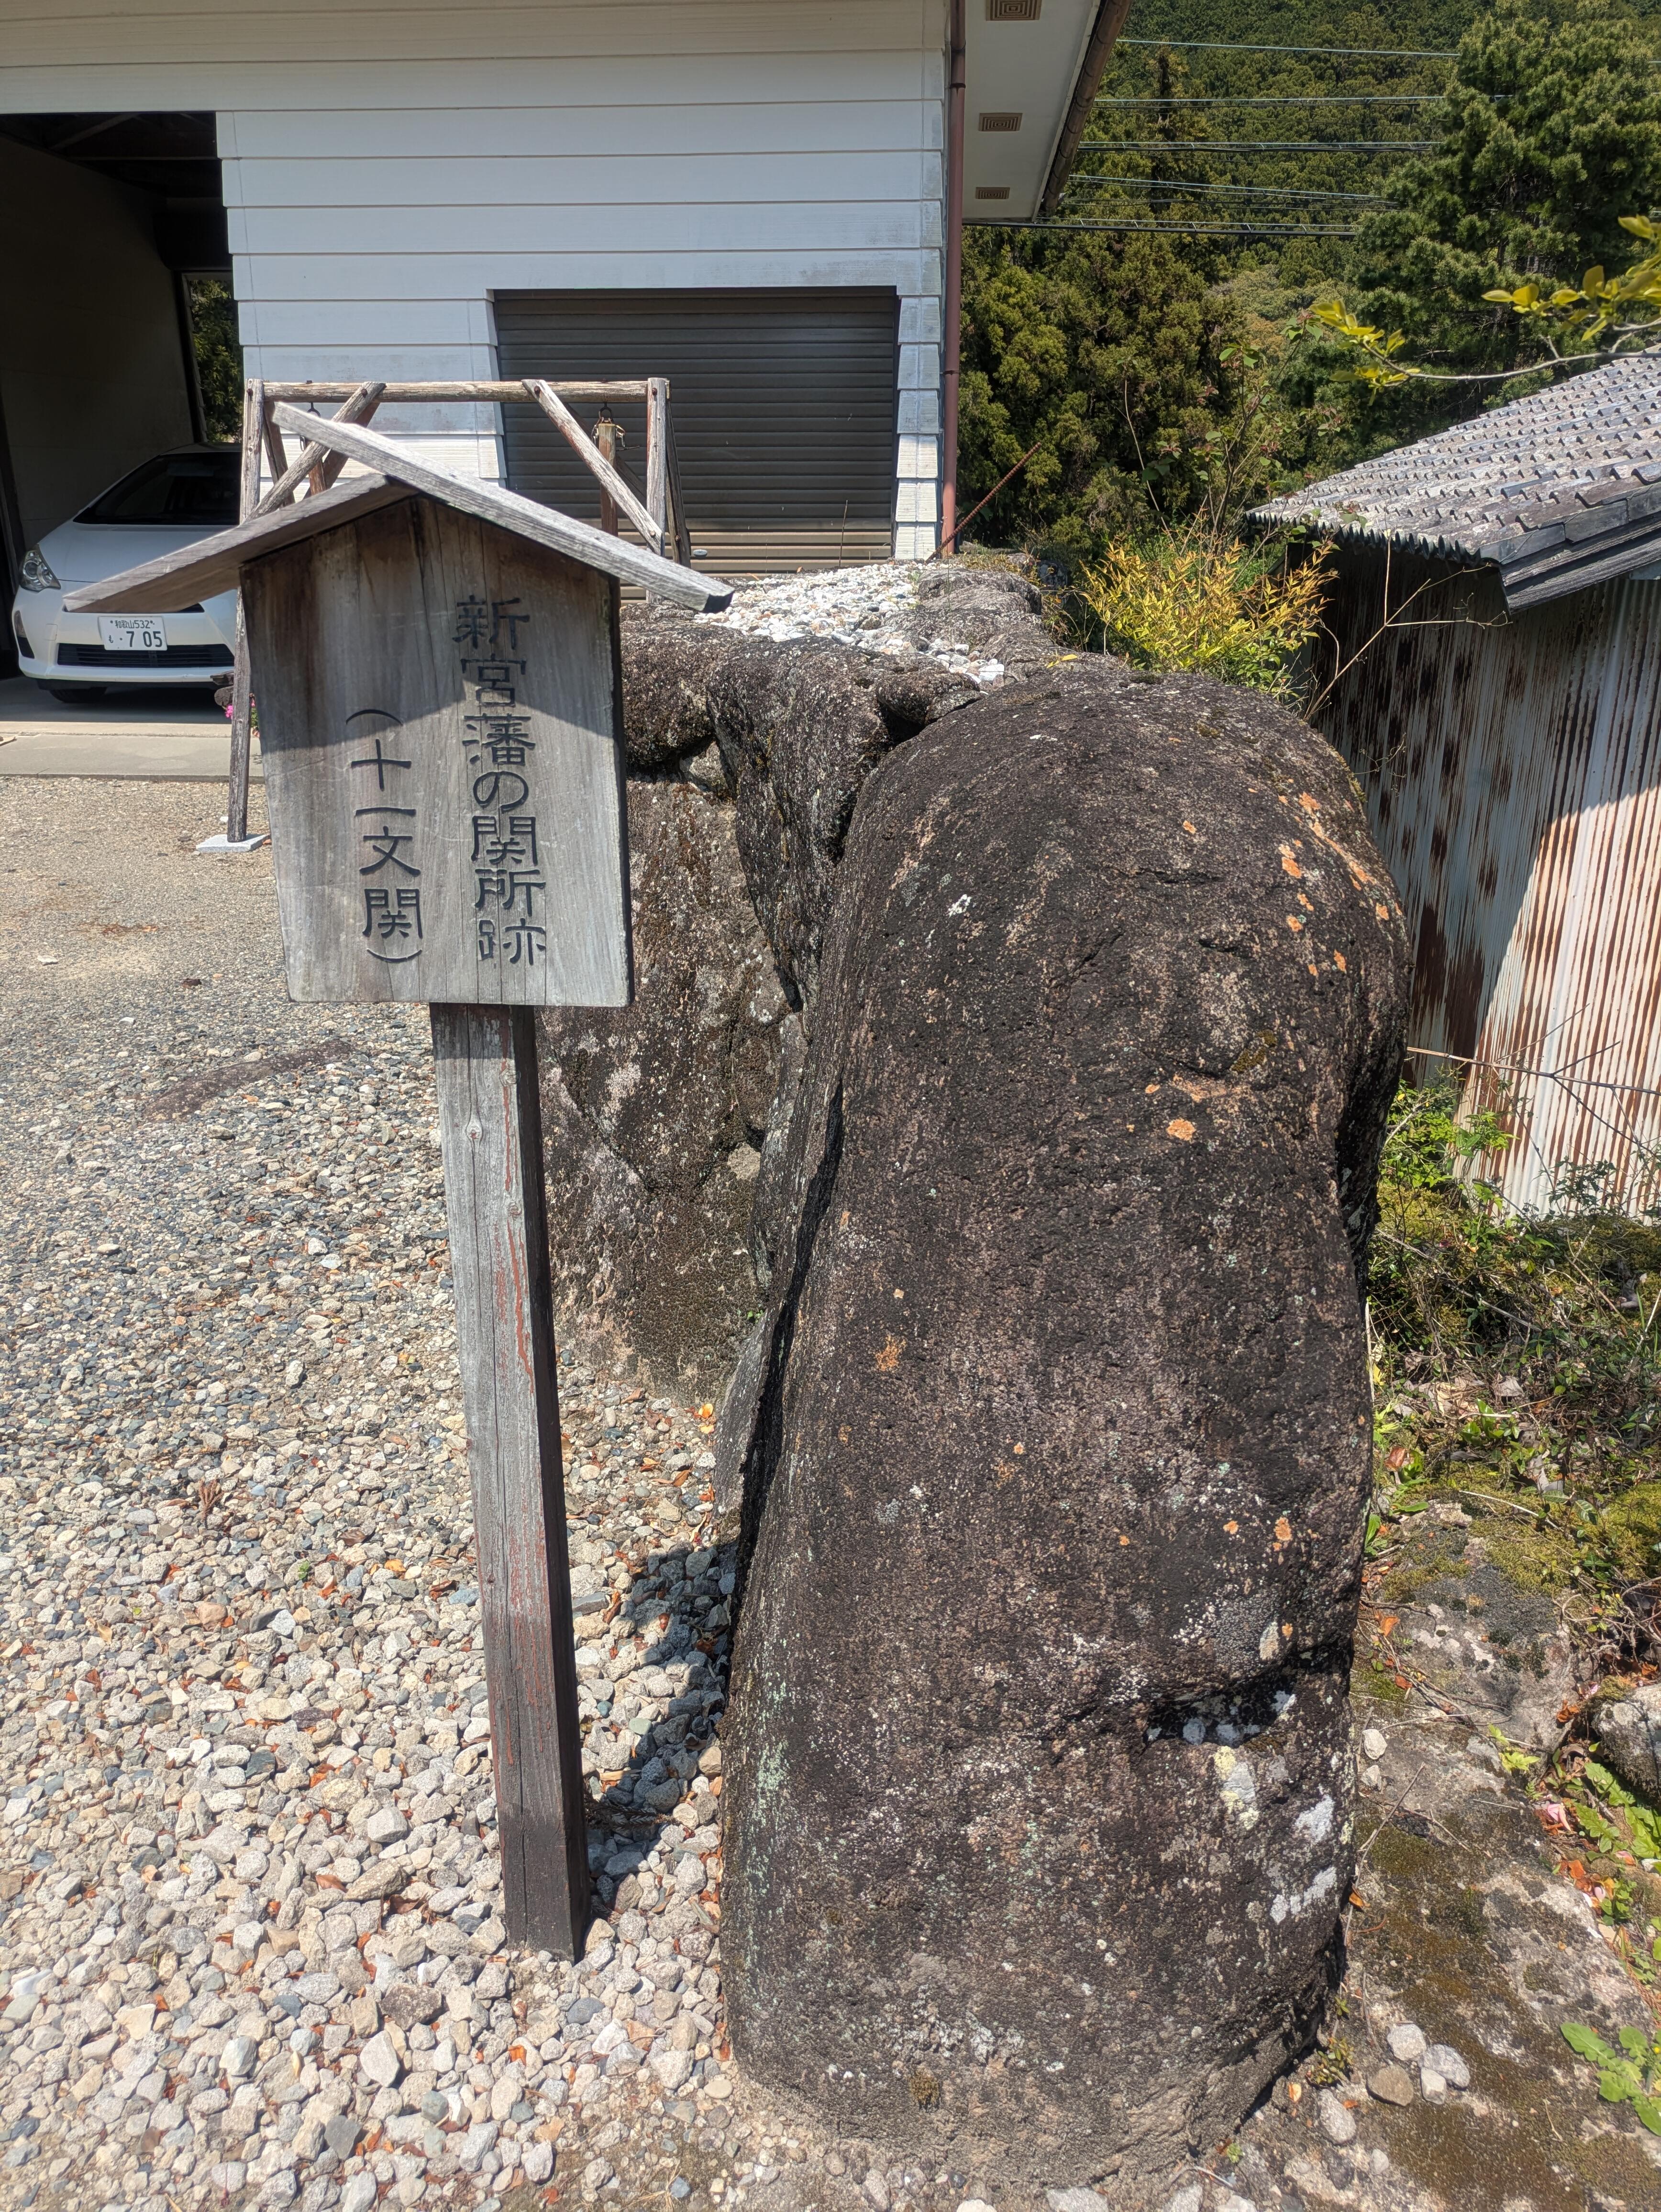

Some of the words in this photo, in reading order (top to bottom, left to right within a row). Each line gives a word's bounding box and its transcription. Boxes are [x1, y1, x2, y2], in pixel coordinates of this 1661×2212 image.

[452, 594, 546, 966] 新宮藩の関所跡
